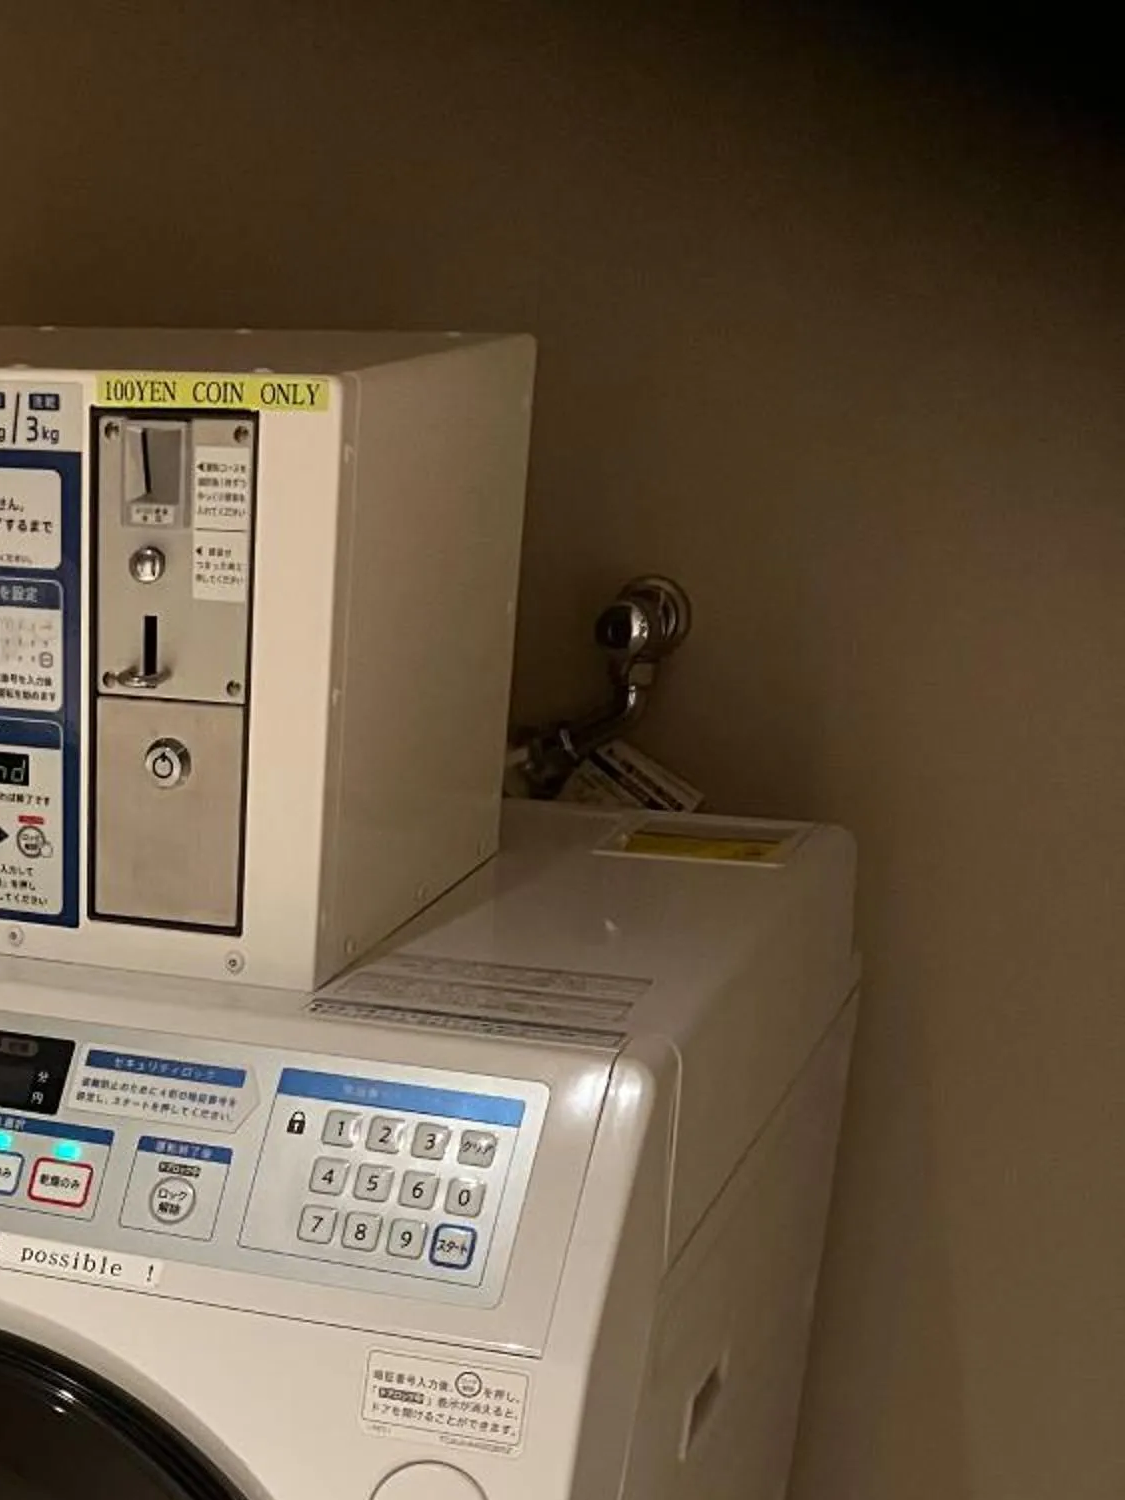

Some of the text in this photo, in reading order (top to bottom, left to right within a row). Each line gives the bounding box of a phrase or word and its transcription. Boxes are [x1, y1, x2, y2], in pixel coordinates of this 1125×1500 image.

[105, 381, 321, 405] 100YEN COIN ONLY
[26, 416, 59, 444] 3kg
[114, 1057, 216, 1080] セキュリティロック
[337, 1121, 345, 1136] 1
[378, 1127, 391, 1144] 2
[424, 1134, 436, 1150] 3
[39, 1172, 80, 1190] 乾燥のみ
[321, 1169, 334, 1185] 4
[366, 1175, 378, 1191] 5
[157, 1188, 188, 1201] ロック
[412, 1181, 424, 1198] 6
[458, 1190, 470, 1206] 0
[312, 1216, 324, 1233] 7
[354, 1224, 367, 1240] 8
[400, 1231, 412, 1248] 9
[20, 1245, 123, 1277] possible
